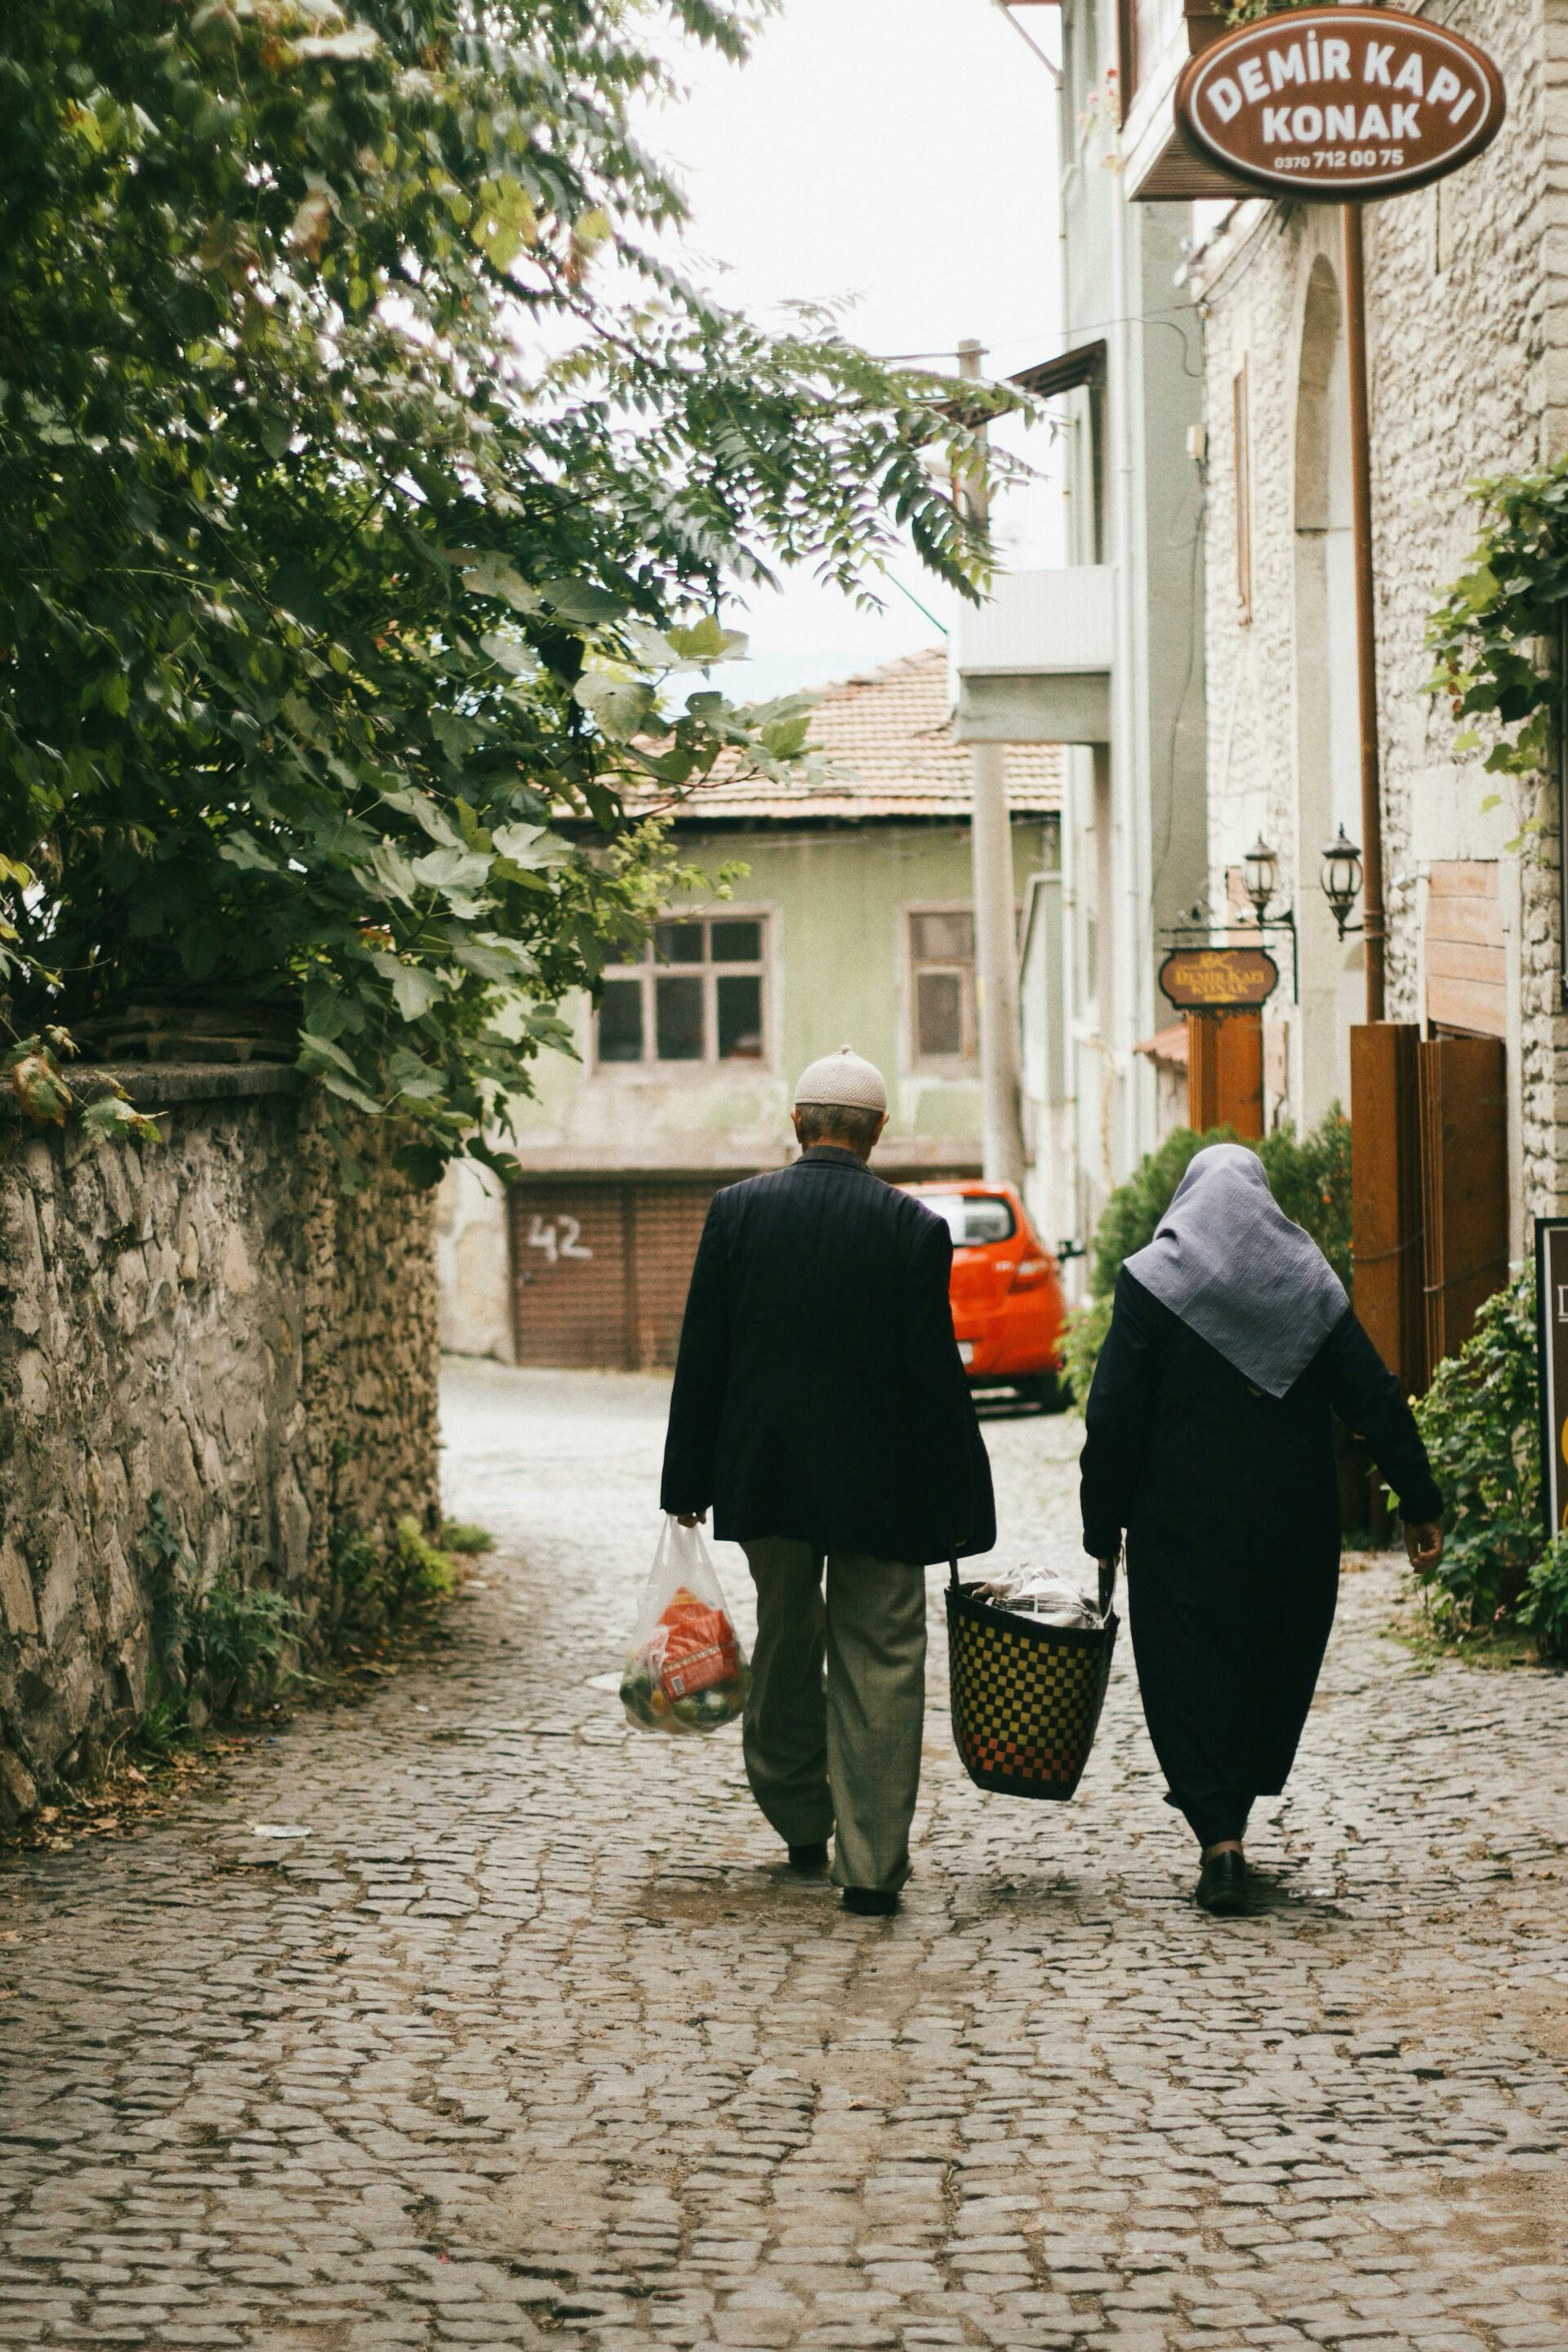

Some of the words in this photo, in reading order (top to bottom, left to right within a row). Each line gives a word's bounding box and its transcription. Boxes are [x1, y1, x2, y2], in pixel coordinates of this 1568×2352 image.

[1206, 30, 1351, 123] DEMİR
[1364, 42, 1477, 124] KAPI
[1263, 103, 1421, 143] KONAK
[1274, 157, 1311, 169] 0370
[1312, 151, 1346, 168] 712
[1349, 149, 1376, 167] 00
[1379, 149, 1405, 167] 75
[528, 1214, 594, 1263] 42
